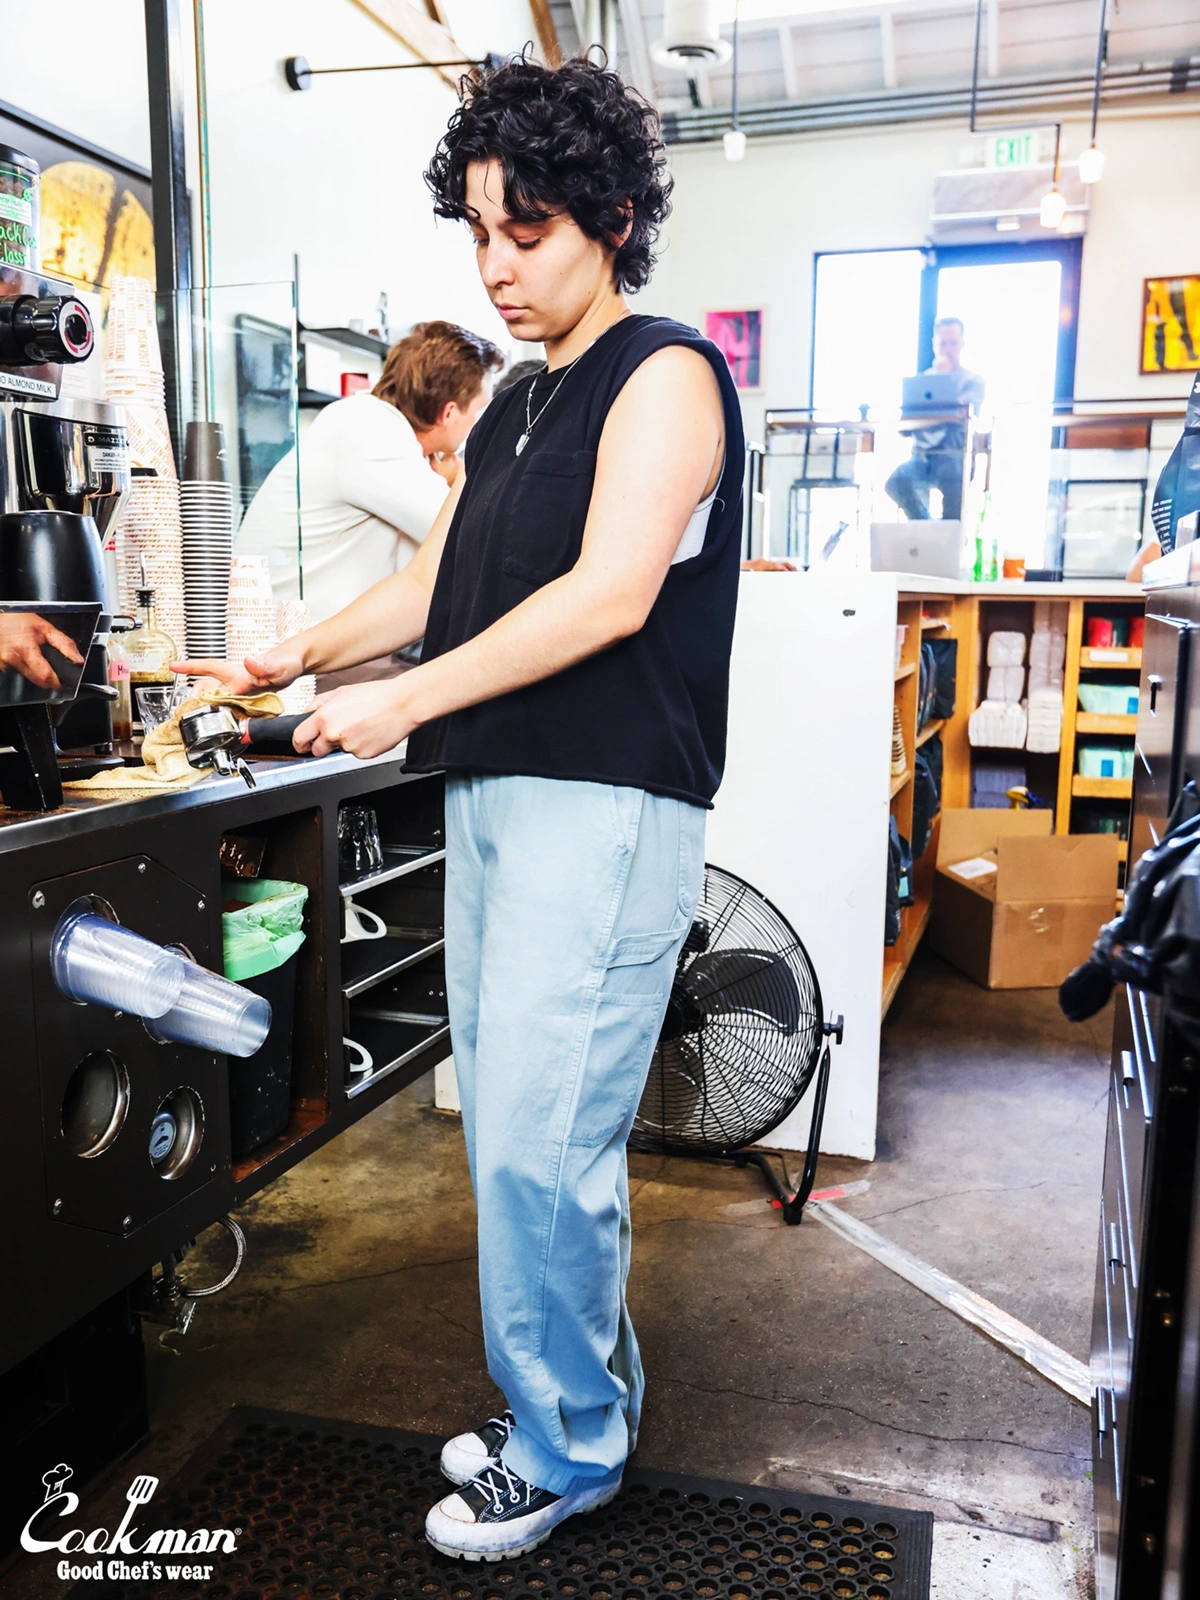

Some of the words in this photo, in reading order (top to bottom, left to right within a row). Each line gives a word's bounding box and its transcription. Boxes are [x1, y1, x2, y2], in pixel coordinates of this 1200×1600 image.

[995, 135, 1031, 167] EXIT
[116, 309, 126, 362] INTELLIGENTSIA
[8, 377, 36, 390] ALMOND
[36, 383, 52, 394] MILK
